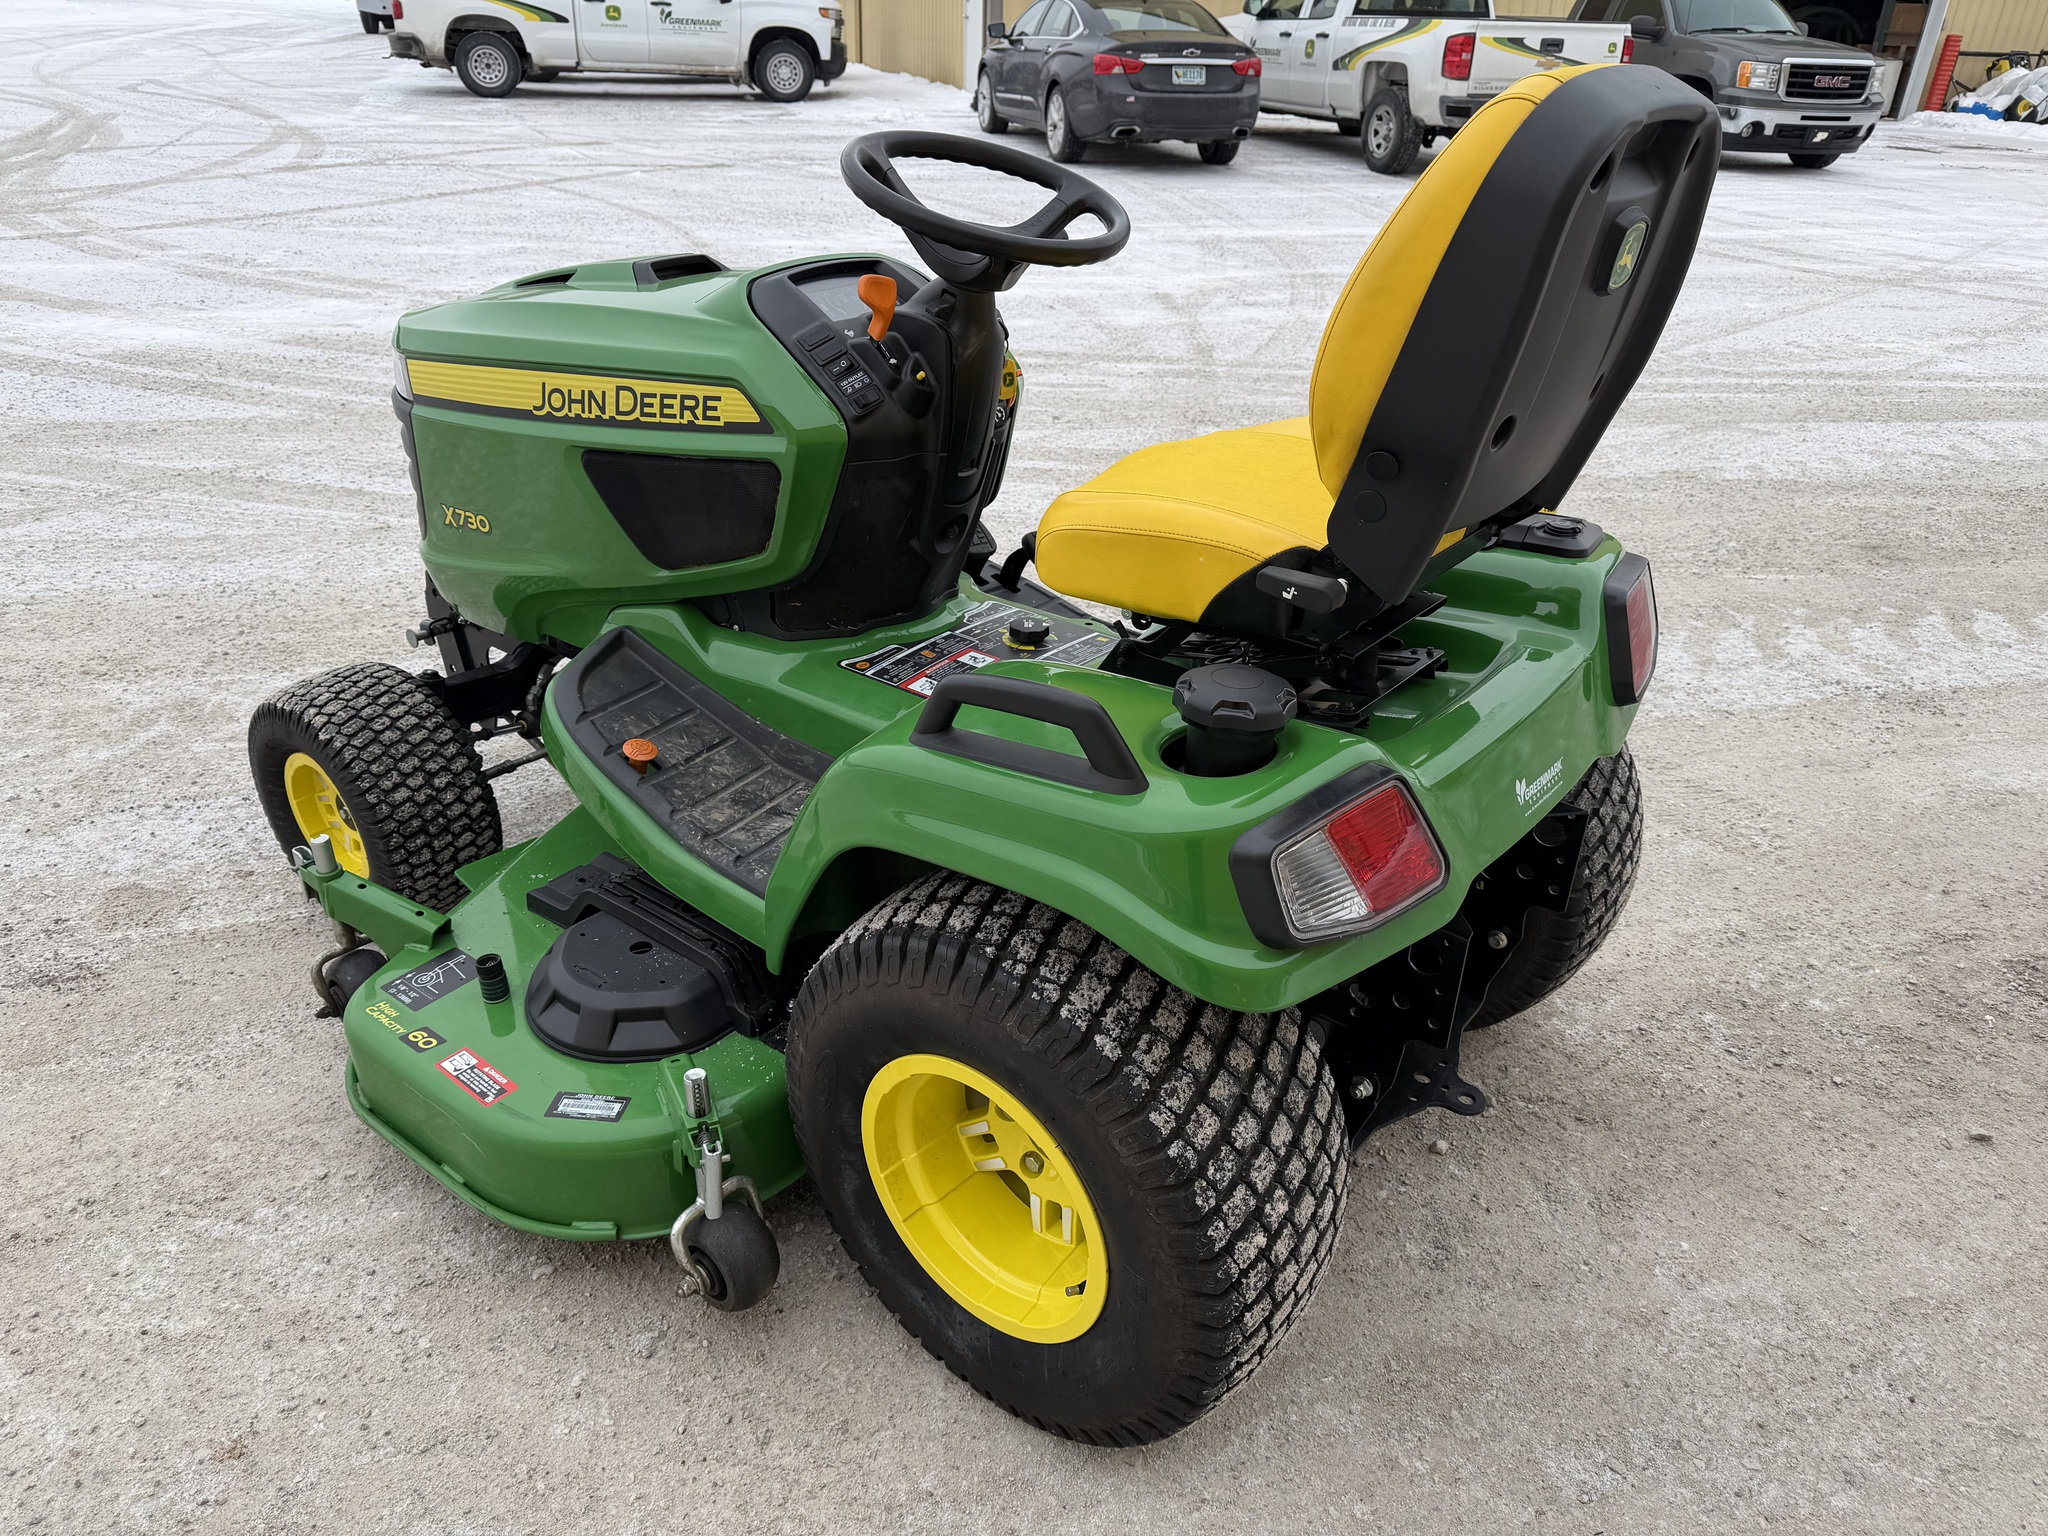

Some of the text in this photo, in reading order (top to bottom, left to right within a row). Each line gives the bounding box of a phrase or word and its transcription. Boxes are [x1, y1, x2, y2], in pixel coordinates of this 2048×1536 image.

[668, 17, 722, 27] GREENMARK
[1814, 75, 1851, 88] GMC
[840, 371, 864, 387] 12V OUTLET
[532, 381, 724, 425] JOHN DEERE
[440, 503, 491, 534] X730
[1525, 758, 1562, 801] GREENMARK
[375, 1001, 400, 1018] HIGH
[365, 1006, 438, 1049] CAPACITY 60
[488, 1067, 508, 1085] DANGER
